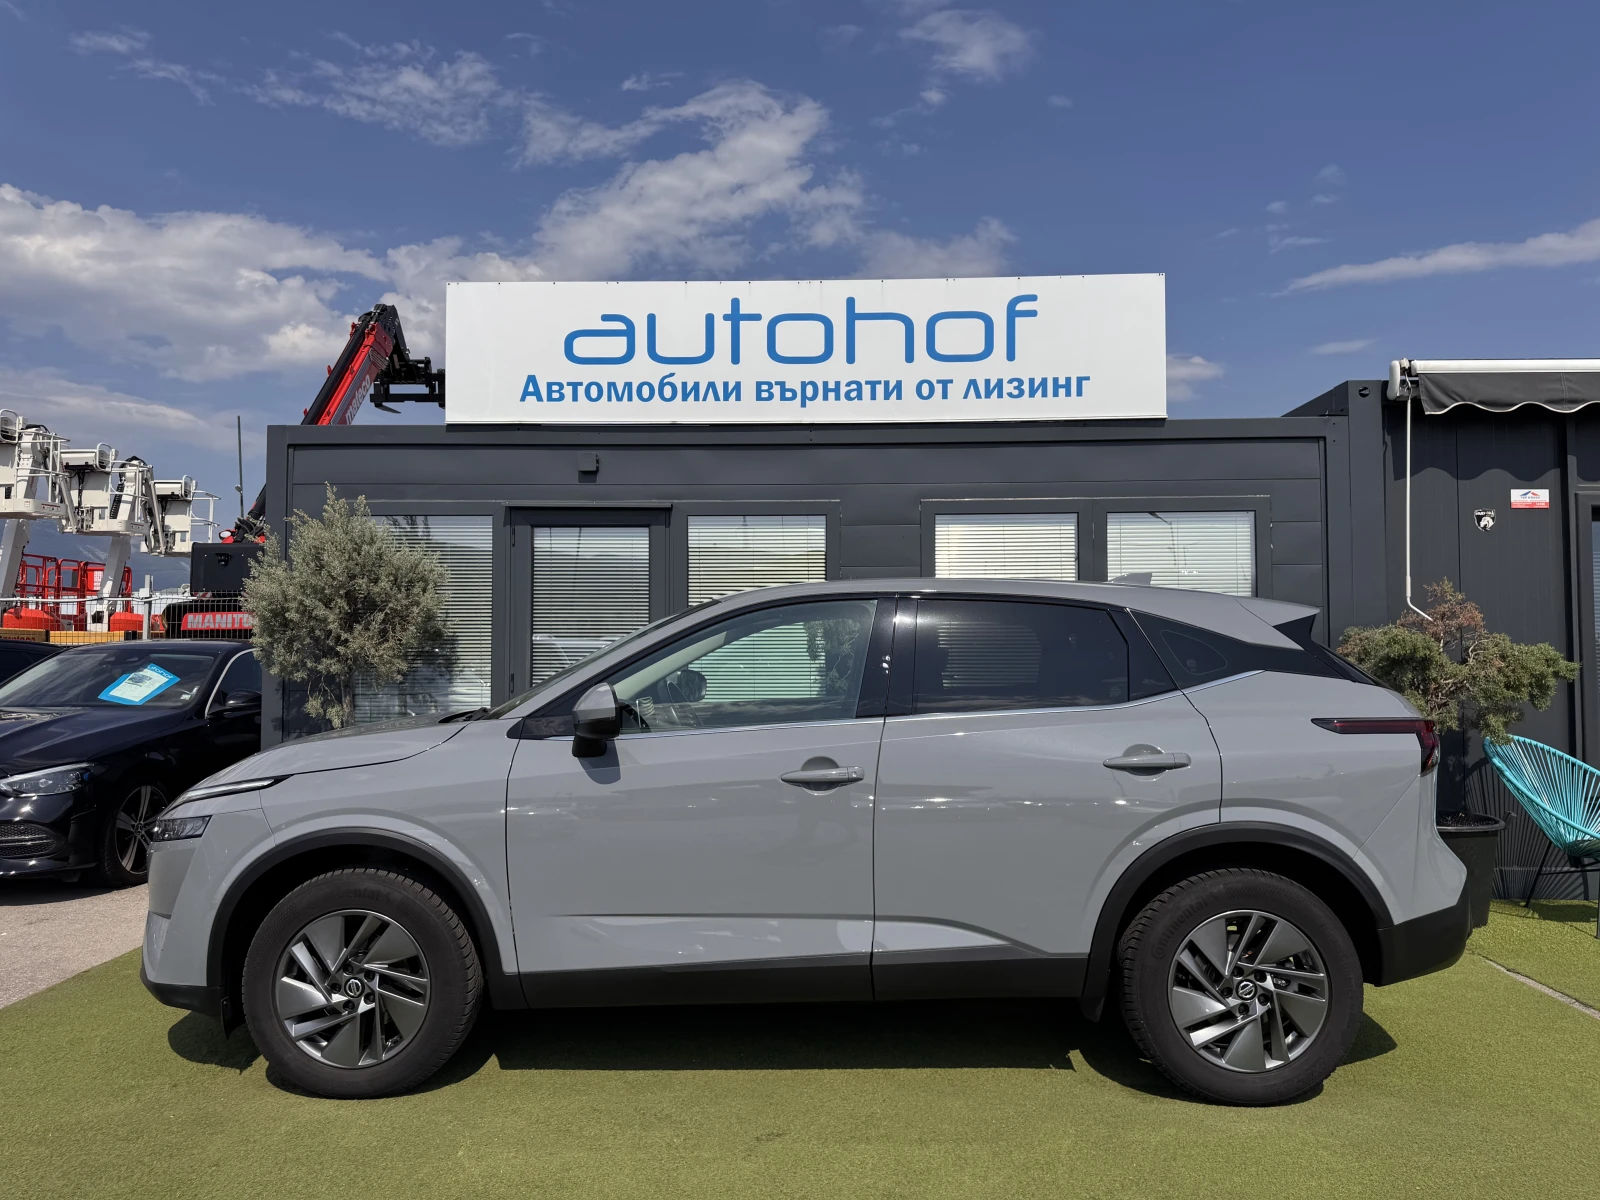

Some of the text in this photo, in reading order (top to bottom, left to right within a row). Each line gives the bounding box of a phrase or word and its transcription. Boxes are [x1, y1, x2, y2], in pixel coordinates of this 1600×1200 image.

[564, 294, 1038, 365] autohof
[345, 374, 371, 425] mateco
[520, 372, 1091, 408] Автомобили върнати от лизинг
[187, 613, 254, 629] MANITO
[148, 665, 174, 679] utohof
